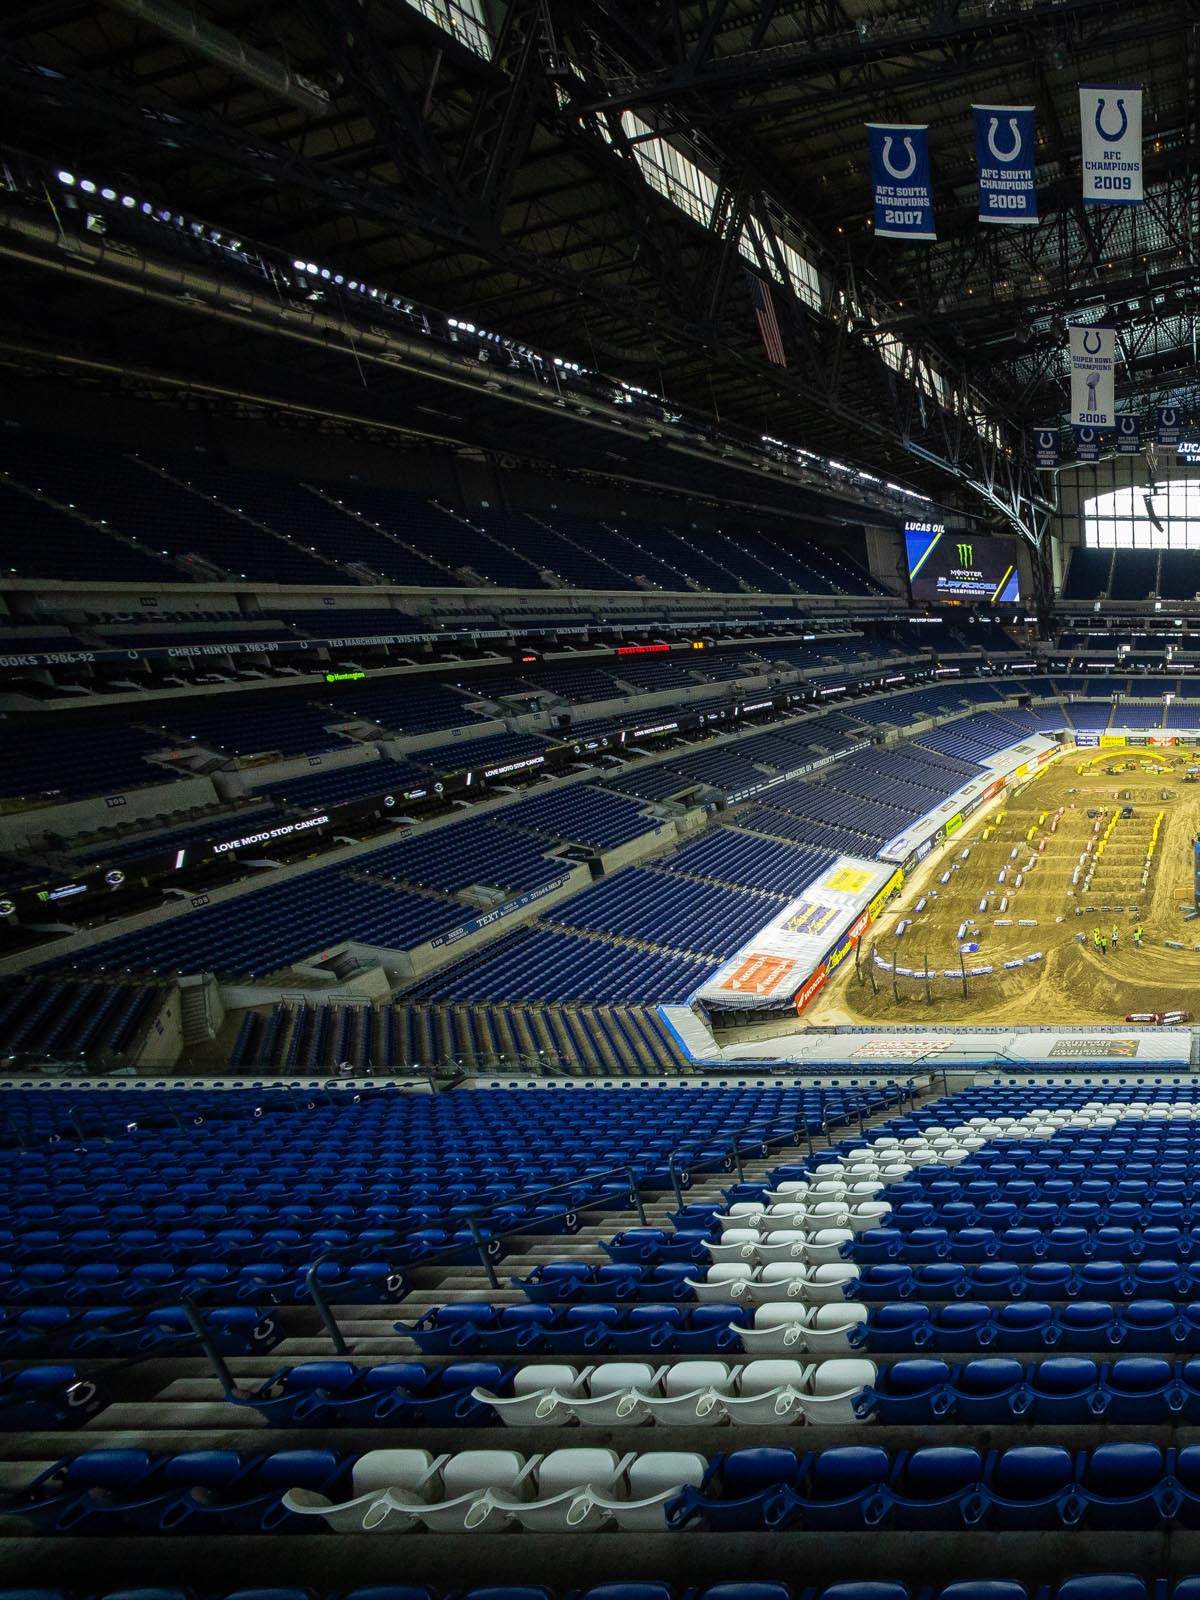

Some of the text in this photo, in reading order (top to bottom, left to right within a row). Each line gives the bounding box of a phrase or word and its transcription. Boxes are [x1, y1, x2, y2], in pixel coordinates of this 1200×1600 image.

[1103, 151, 1121, 161] AFC
[1085, 161, 1140, 172] CHAMPIONS
[981, 169, 1031, 180] AFC SOUTH
[980, 179, 1034, 190] CHAMPIONS
[1094, 176, 1131, 190] 2009
[876, 186, 927, 198] AFC SOUTH
[875, 196, 930, 207] CHAMPIONS
[989, 194, 1026, 208] 2009
[885, 210, 922, 225] 2007
[1073, 355, 1094, 363] SUPER
[1074, 363, 1112, 371] CHAMPIONS
[1079, 413, 1107, 423] 2006
[905, 522, 945, 533] LUCAS OIL
[950, 569, 983, 578] MONSTER
[168, 647, 201, 657] CHRIS
[203, 645, 241, 656] HINTON
[46, 652, 96, 665] 1986-92
[485, 756, 545, 778] LOVE MOTO STOP CANCER
[213, 815, 330, 854] LOVE MOTO STOP CANCER
[476, 911, 499, 928] TEXT
[448, 927, 464, 938] NEED
[804, 973, 825, 1000] HONDA
